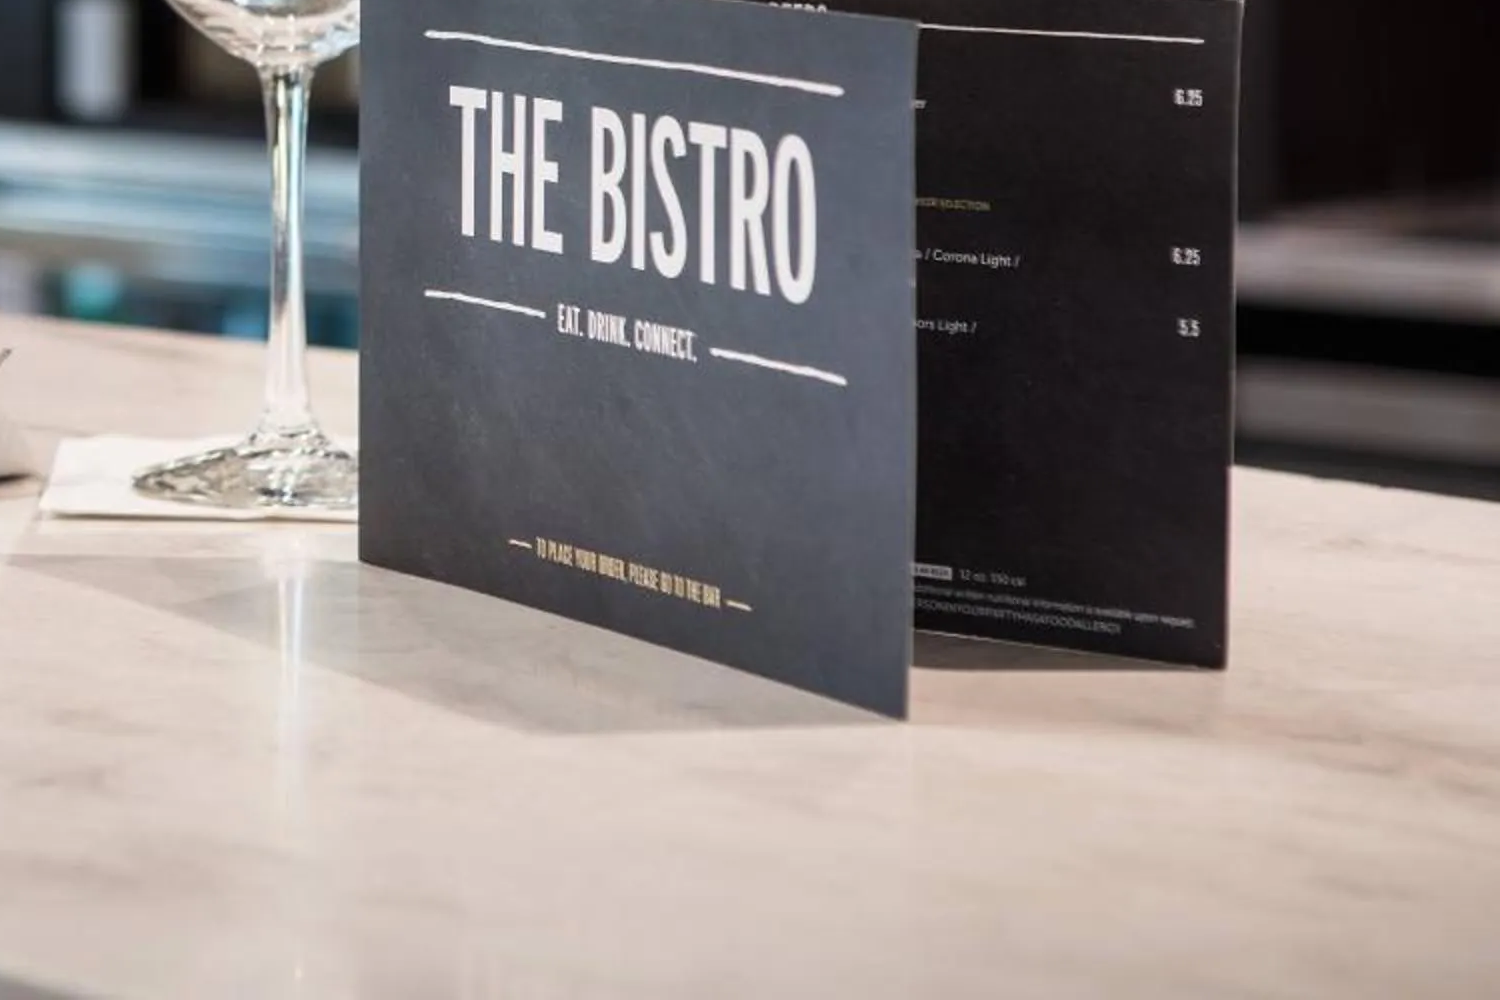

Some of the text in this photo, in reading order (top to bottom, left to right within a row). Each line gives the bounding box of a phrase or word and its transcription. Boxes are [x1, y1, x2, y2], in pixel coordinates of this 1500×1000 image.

[1174, 88, 1203, 107] 6.25
[449, 85, 817, 304] THE BISTRO
[933, 249, 978, 264] Corona
[980, 252, 1011, 269] Light
[1172, 247, 1200, 265] 6.25
[557, 303, 698, 363] EAT. DRINK. CONNECT.
[938, 320, 968, 335] Light
[1177, 318, 1200, 338] 5.5
